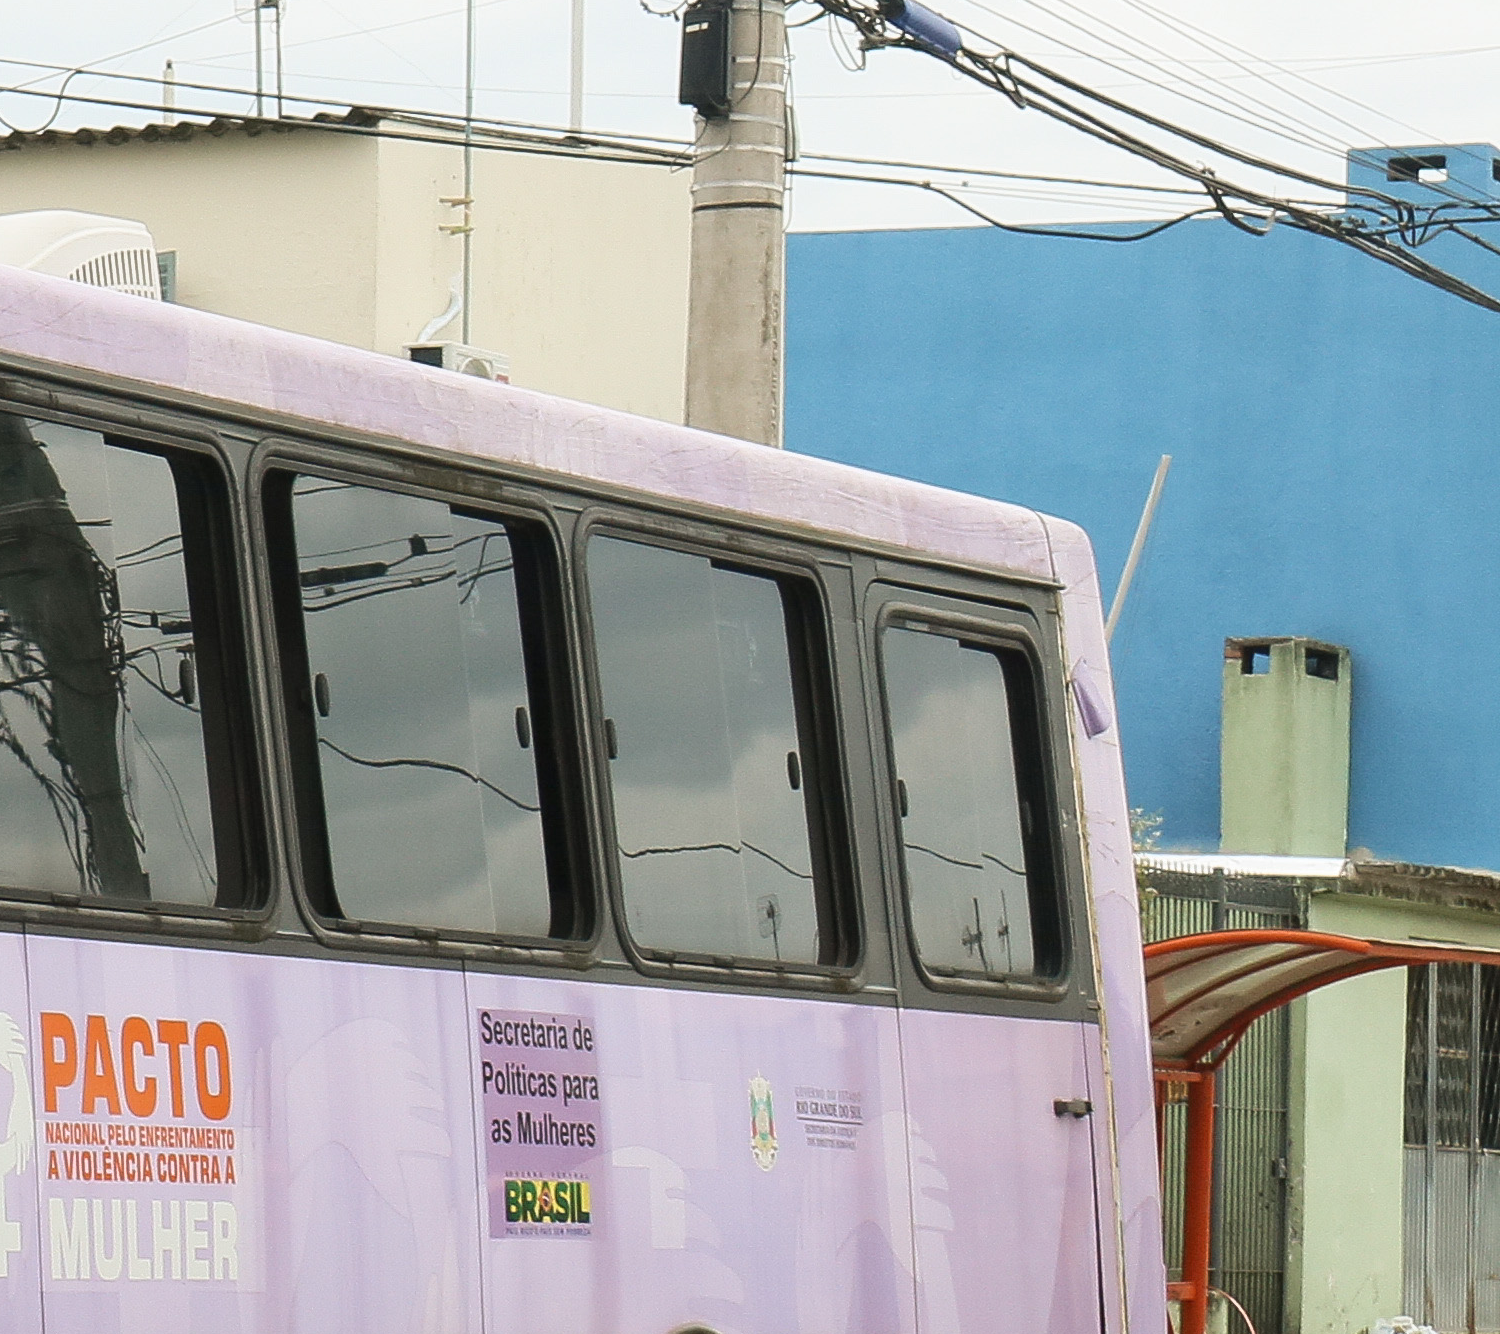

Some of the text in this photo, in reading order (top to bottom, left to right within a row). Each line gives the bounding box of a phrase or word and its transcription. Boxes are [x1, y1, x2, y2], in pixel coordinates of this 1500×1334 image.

[480, 1010, 594, 1053] Secretaria de
[39, 1011, 233, 1121] PACTO
[481, 1060, 600, 1107] Políticas para
[45, 1122, 235, 1150] NACIONAL PELO ENFRENTAMENTO
[491, 1110, 596, 1148] as Mulheres
[47, 1146, 236, 1185] A VIOLÊNCIA CONTRA A
[504, 1179, 591, 1224] BRASIL
[49, 1197, 239, 1281] MULHER
